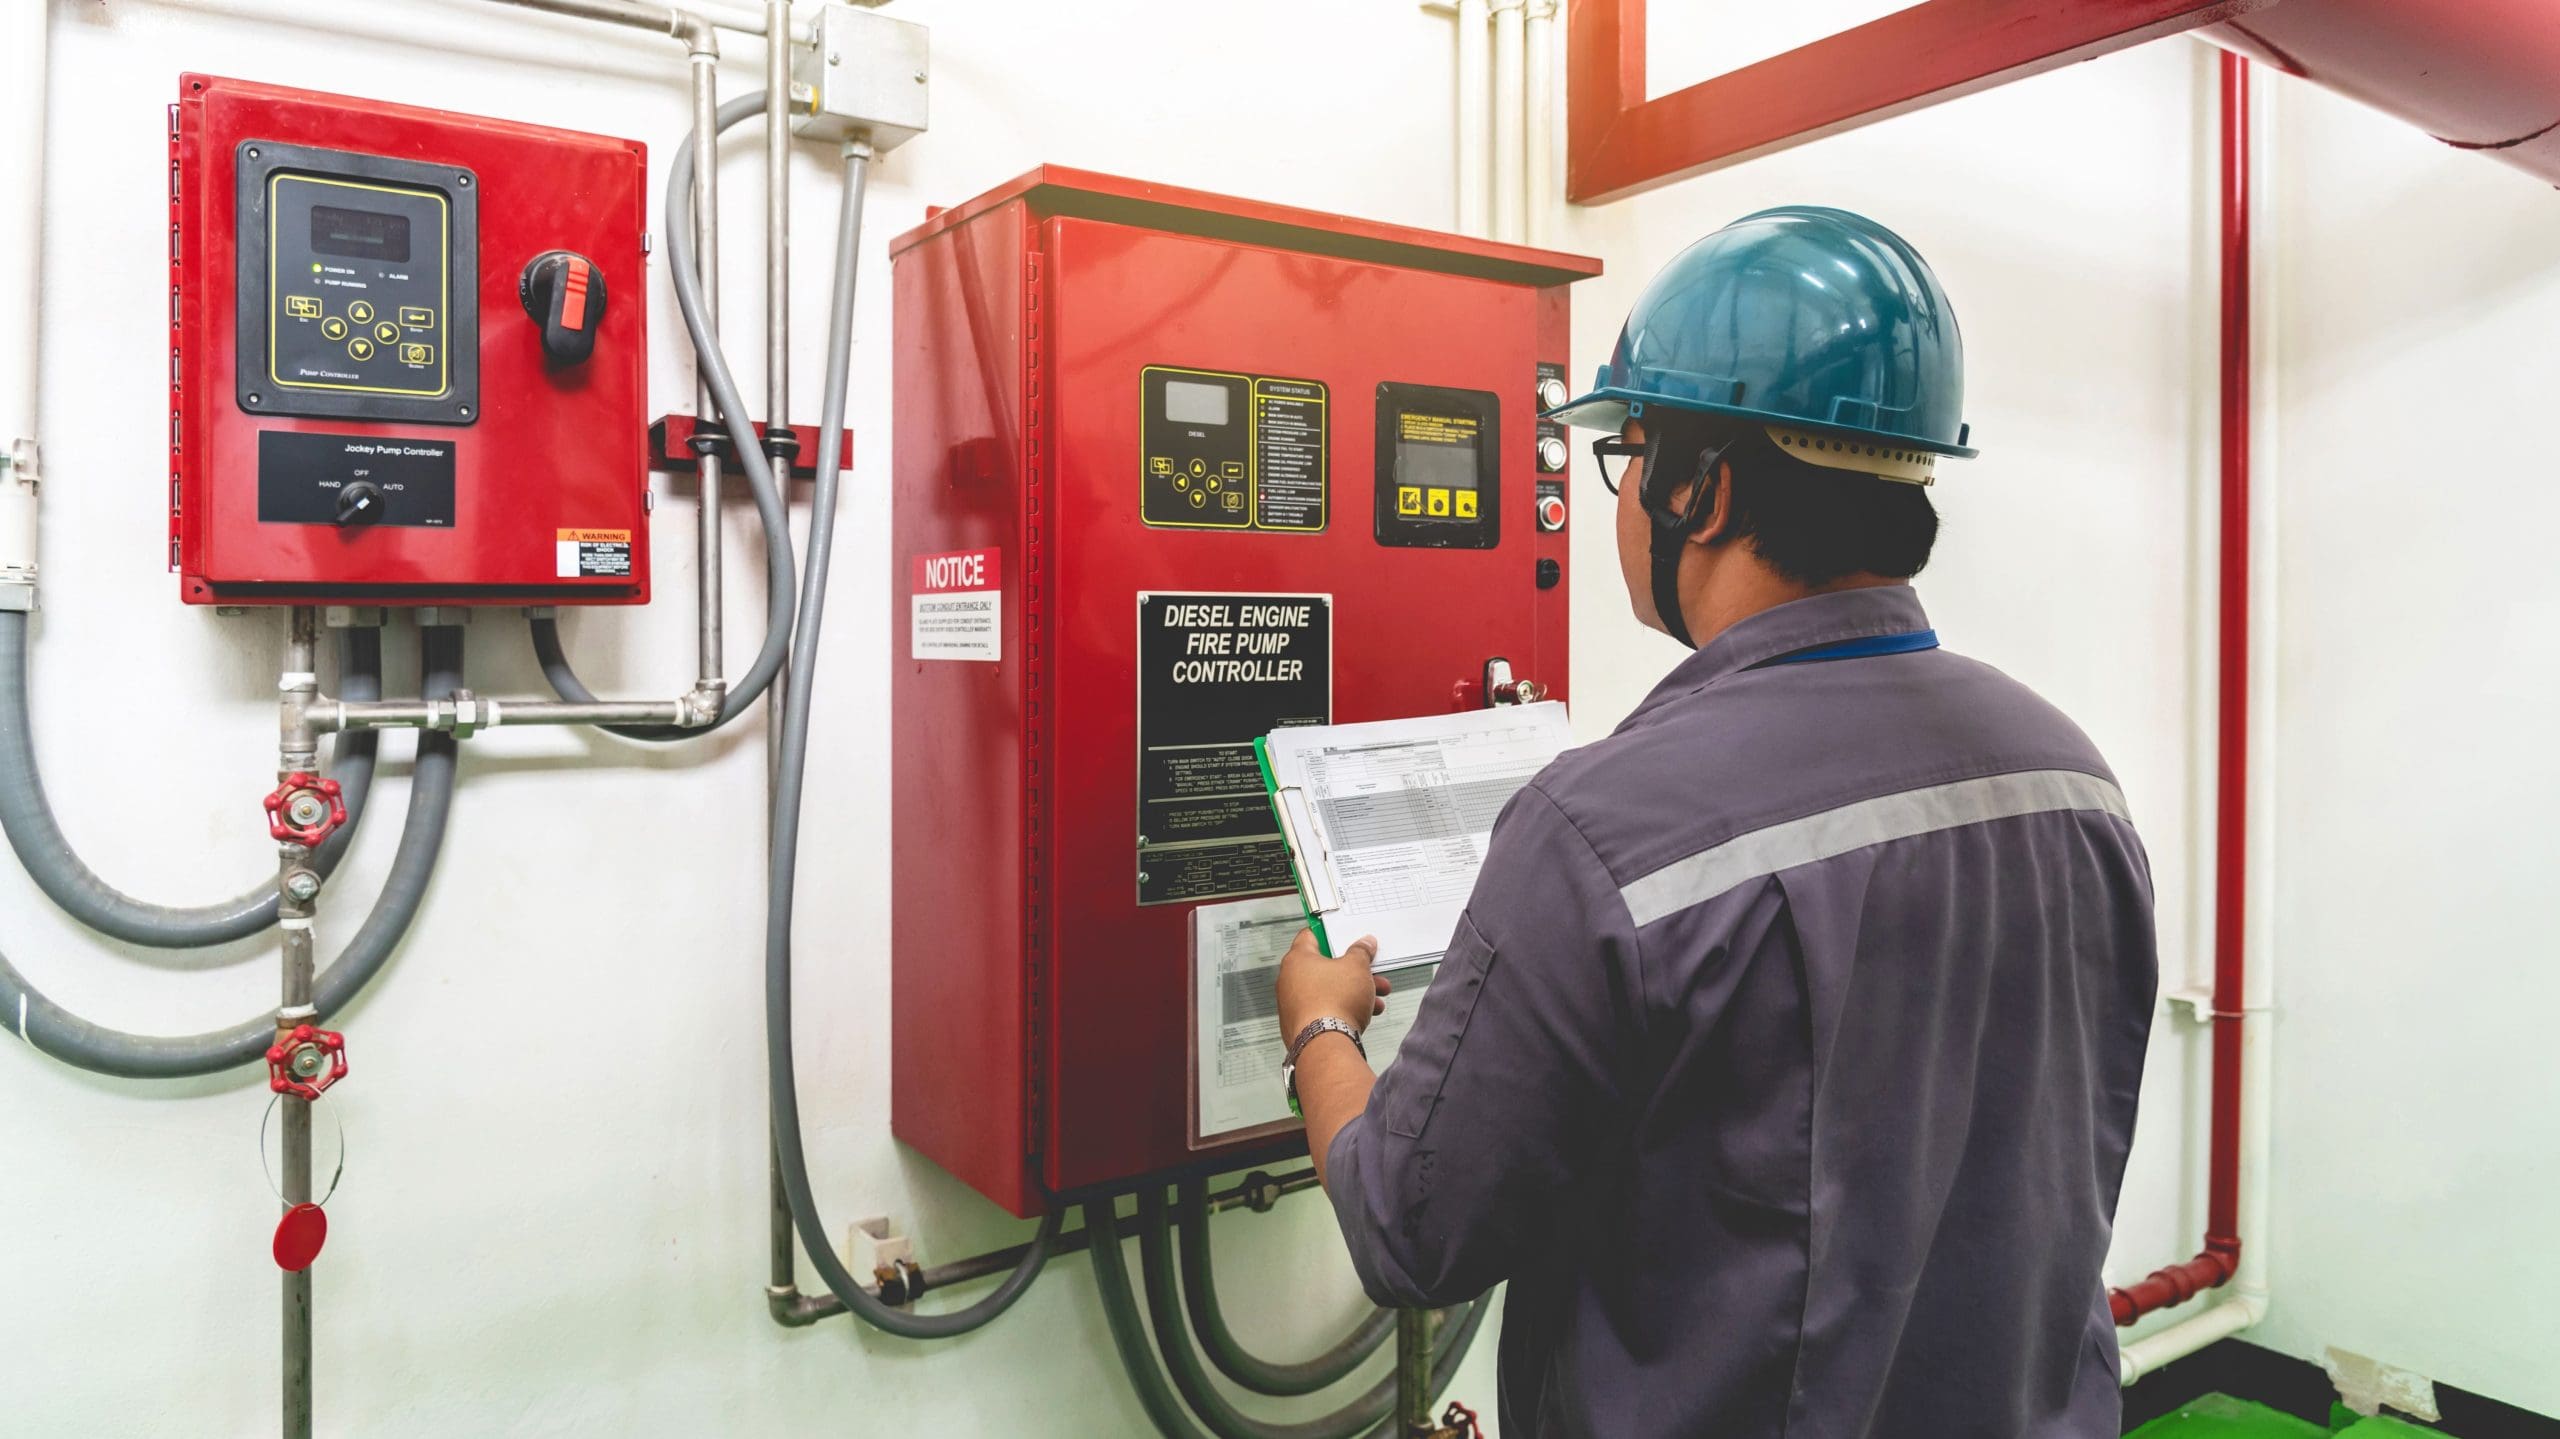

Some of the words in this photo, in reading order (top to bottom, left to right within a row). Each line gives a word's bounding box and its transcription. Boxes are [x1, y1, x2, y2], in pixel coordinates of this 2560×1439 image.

[345, 444, 375, 455] Jockey
[376, 445, 402, 456] Pump
[403, 447, 444, 457] Controller
[583, 533, 626, 541] WARNING
[926, 555, 985, 589] NOTICE
[1164, 605, 1234, 627] DIESEL
[1239, 605, 1311, 628] ENGINE
[1186, 633, 1232, 655] FIRE
[1235, 633, 1290, 655] PUMP
[1172, 660, 1303, 683] CONTROLLER
